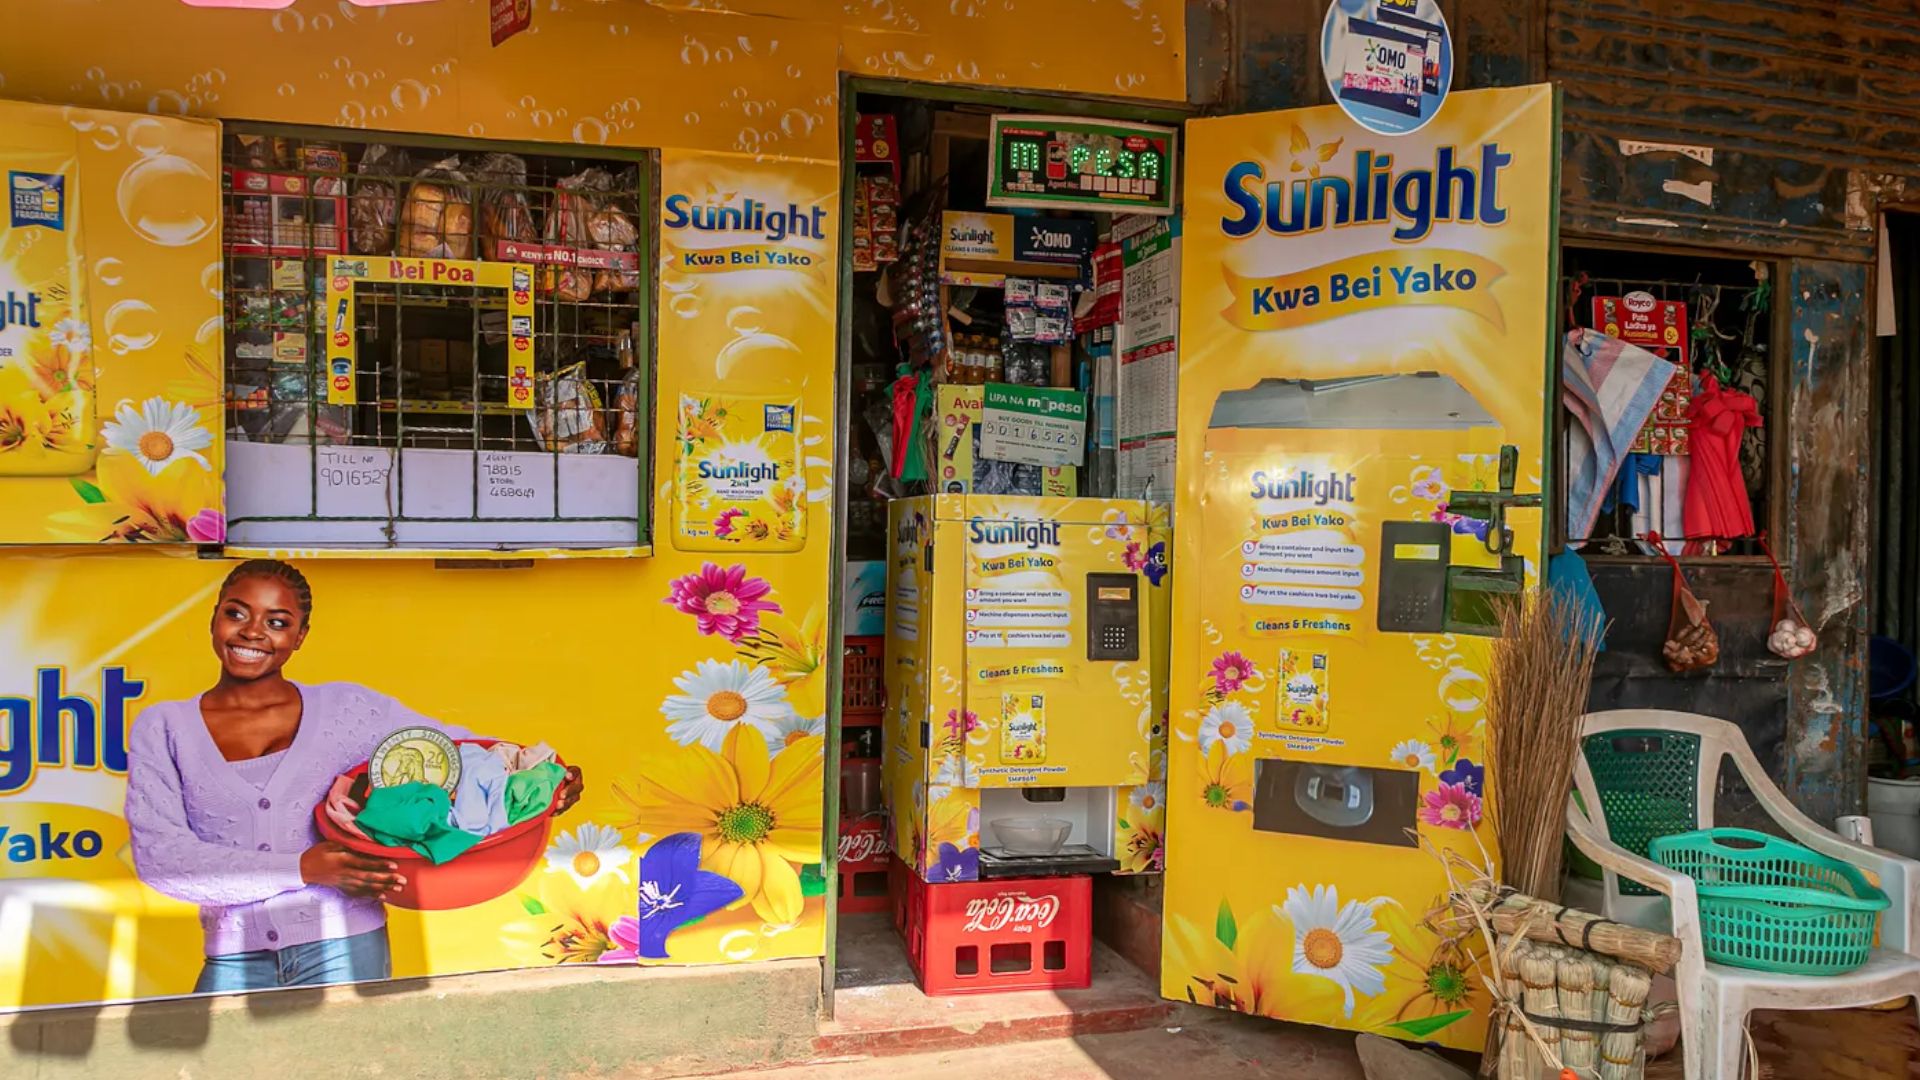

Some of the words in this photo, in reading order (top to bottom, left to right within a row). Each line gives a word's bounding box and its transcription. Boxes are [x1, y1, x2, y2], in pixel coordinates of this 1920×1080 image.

[1379, 47, 1406, 69] OMO
[1221, 143, 1511, 241] Sunlight
[664, 194, 827, 241] Sunlight
[950, 228, 994, 244] Sunlight
[1045, 232, 1072, 248] OMO
[685, 253, 725, 266] Kwa
[731, 250, 760, 265] Bei
[765, 251, 811, 266] Yako
[389, 260, 424, 279] Bei
[432, 261, 474, 282] Poa
[1252, 284, 1320, 315] Kwa
[1330, 266, 1381, 303] Bei
[1389, 264, 1477, 295] Yako
[1628, 298, 1651, 309] Royco
[989, 393, 1007, 403] LIPA
[1009, 396, 1024, 406] NA
[320, 452, 356, 464] TILL
[320, 468, 389, 487] 9016529
[482, 465, 522, 476] 78815
[698, 461, 780, 483] Sunlight
[730, 480, 750, 488] 2in1
[1251, 470, 1357, 505] Sunlight
[1262, 518, 1288, 529] Kwa
[1291, 514, 1311, 527] Bei
[1314, 514, 1344, 526] Yako
[970, 516, 1061, 549] Sunlight
[982, 561, 1005, 571] Kwa
[1008, 557, 1024, 568] Bei
[1027, 557, 1053, 567] Yako
[1284, 567, 1315, 575] dispenses
[1255, 621, 1289, 631] Cleans
[1292, 620, 1299, 628] &
[1302, 619, 1351, 631] Freshens
[979, 668, 1010, 679] Cleans
[1013, 666, 1019, 675] &
[1021, 665, 1064, 675] Freshens
[1286, 682, 1319, 696] Sunlight
[1009, 722, 1037, 733] Sunlight
[1258, 732, 1287, 740] Synthetic
[1288, 735, 1320, 743] Detergent
[1321, 736, 1344, 744] Powder
[428, 751, 445, 764] 20
[1010, 767, 1041, 775] Detergent
